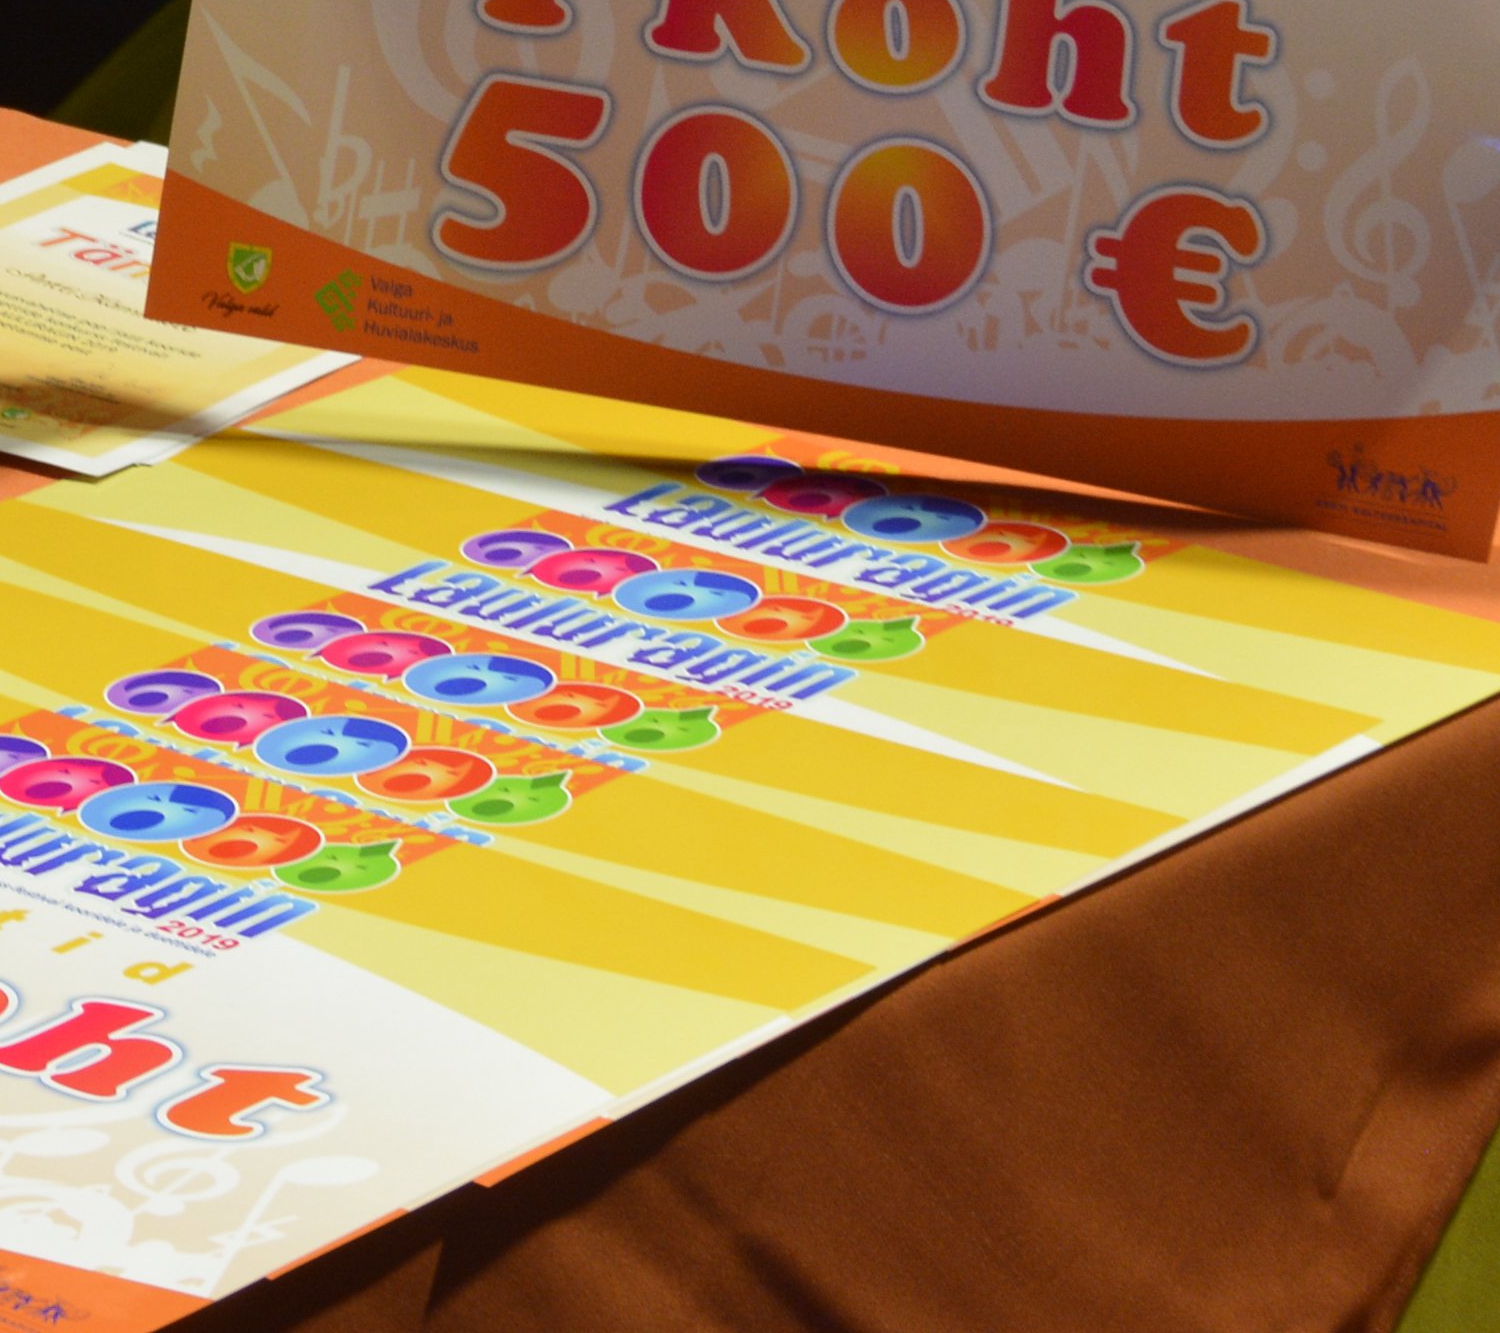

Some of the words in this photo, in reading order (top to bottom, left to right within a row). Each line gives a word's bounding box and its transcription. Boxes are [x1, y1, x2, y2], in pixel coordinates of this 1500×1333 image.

[433, 72, 991, 313] 500
[1083, 184, 1264, 368] €
[603, 480, 1080, 620] Lauluragin
[367, 558, 860, 701] Lauluragin
[154, 919, 241, 952] 2019
